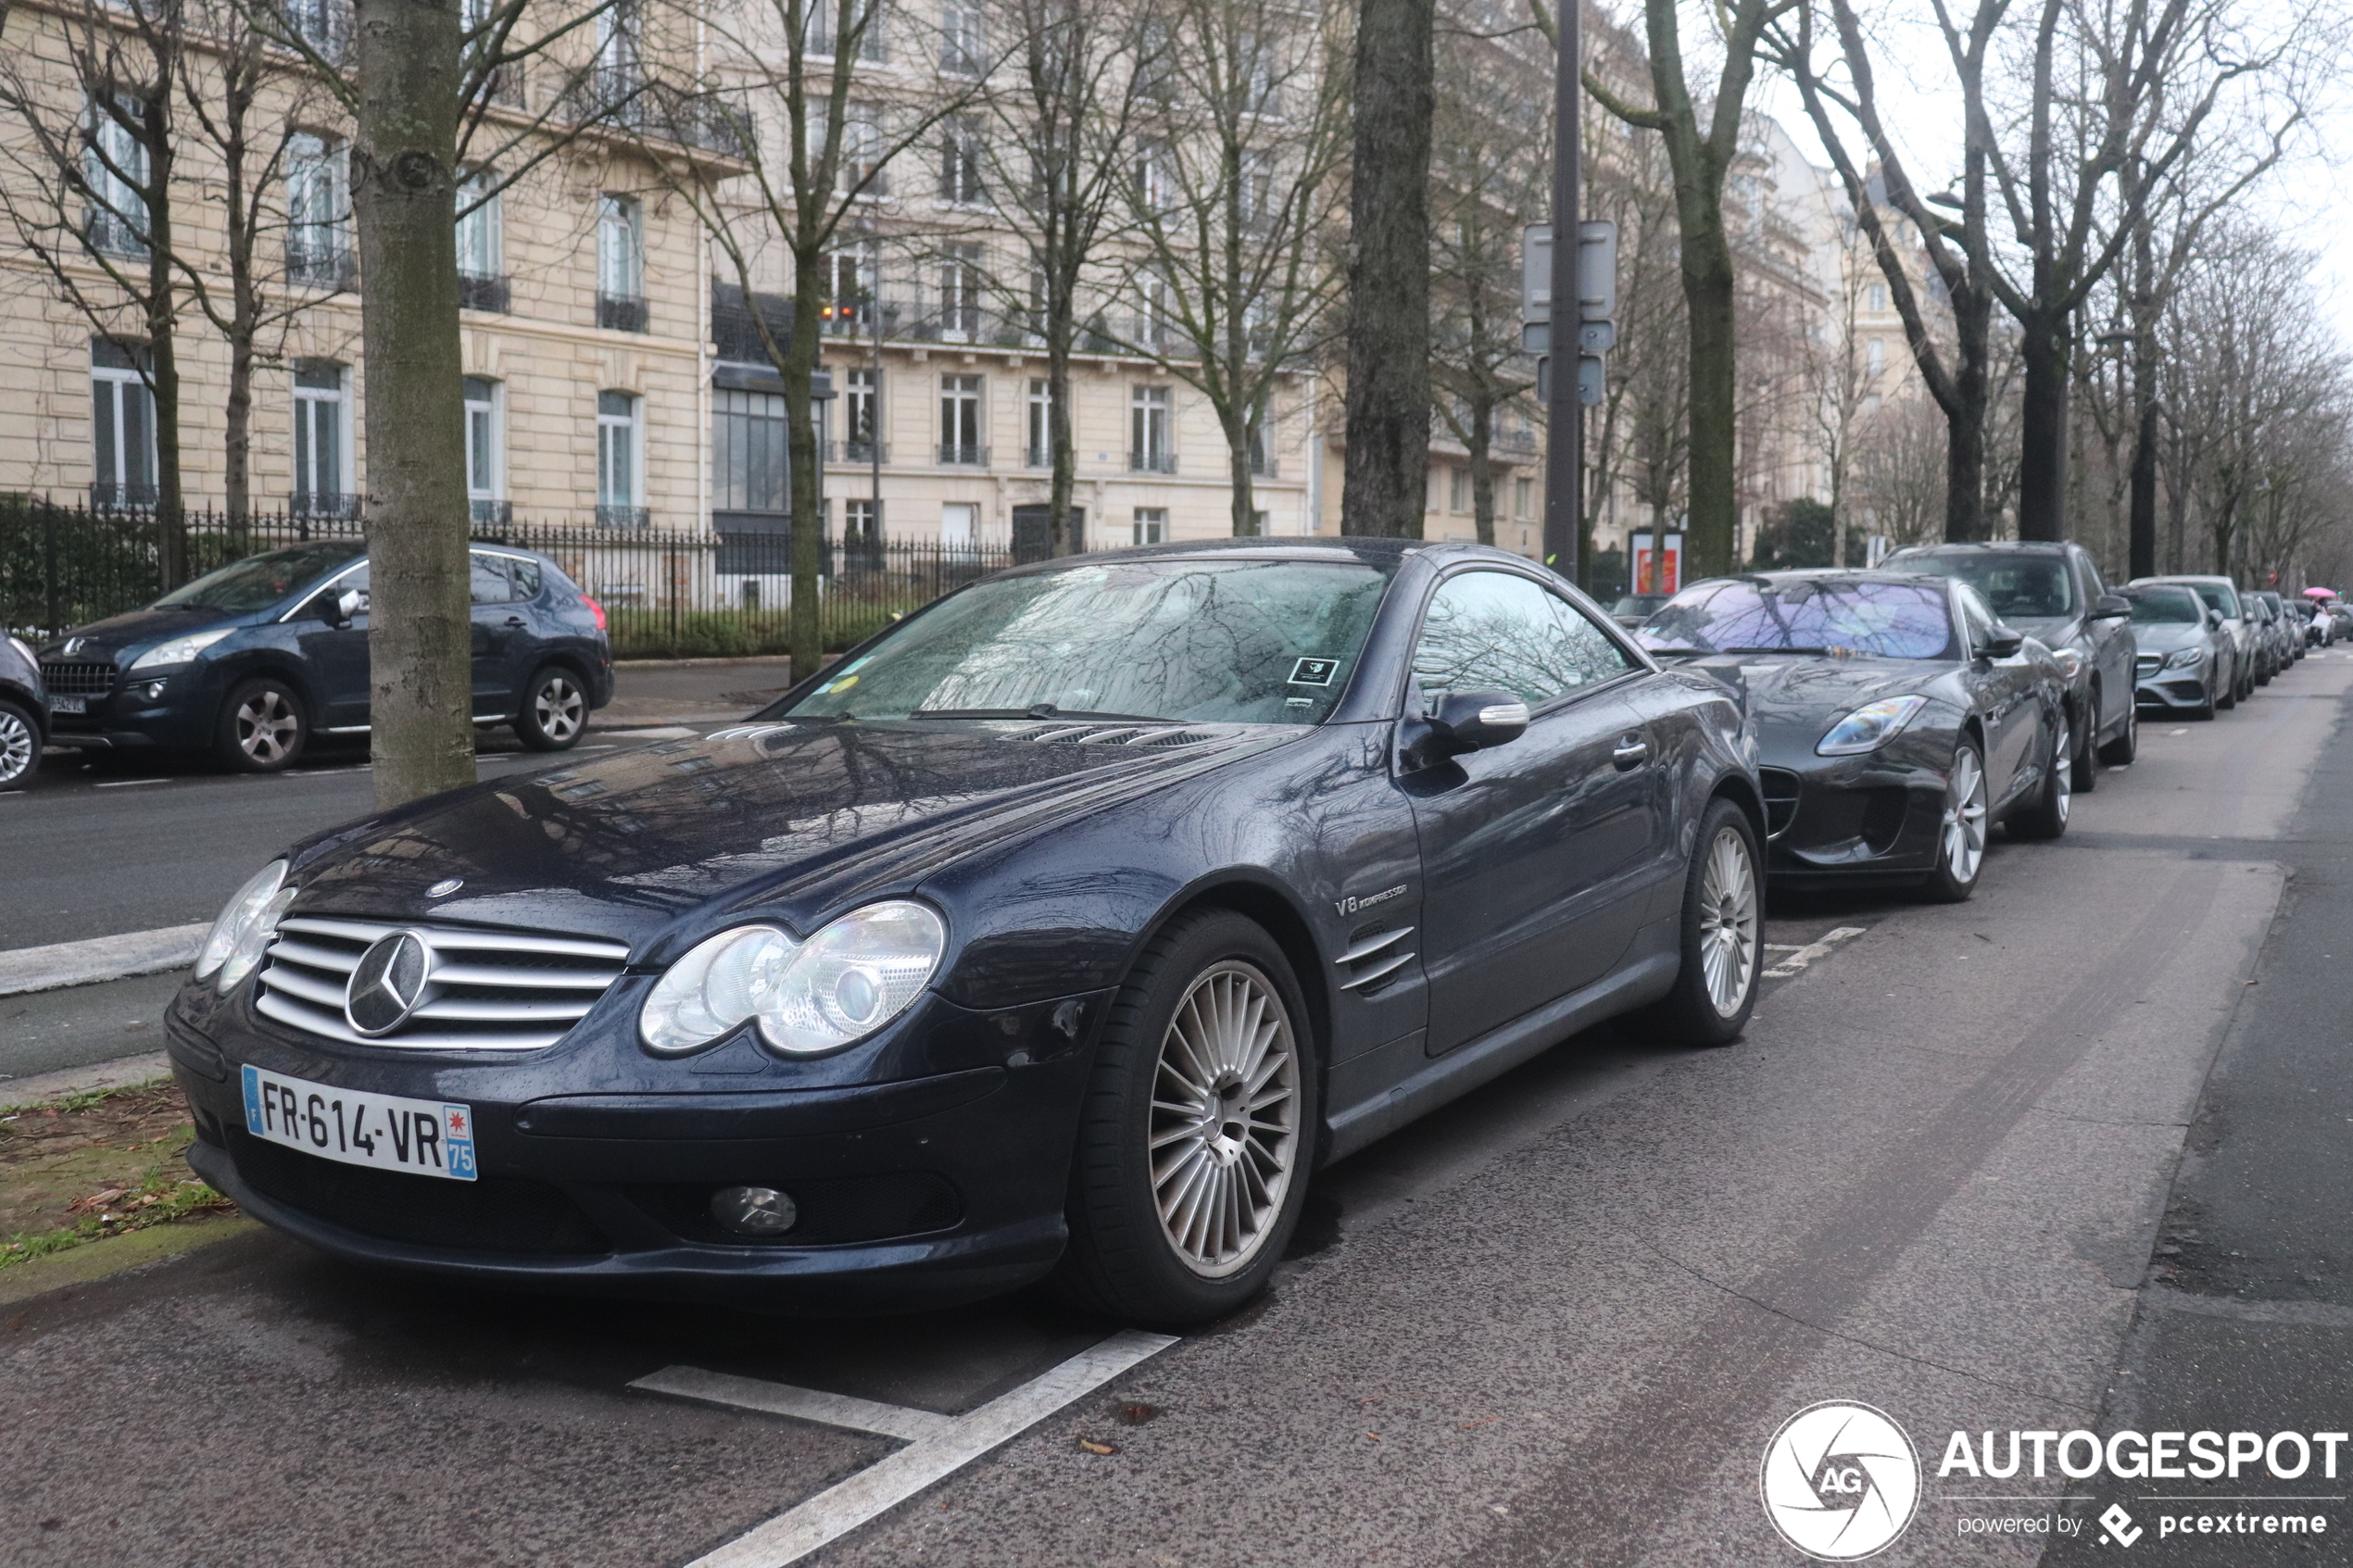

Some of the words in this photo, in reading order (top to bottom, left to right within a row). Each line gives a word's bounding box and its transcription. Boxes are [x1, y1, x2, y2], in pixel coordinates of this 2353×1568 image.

[1335, 896, 1358, 917] V8
[1358, 884, 1407, 909] KOMPRESSOR
[250, 1108, 257, 1123] F
[262, 1080, 443, 1168] FR-614-VR
[448, 1143, 473, 1172] 75
